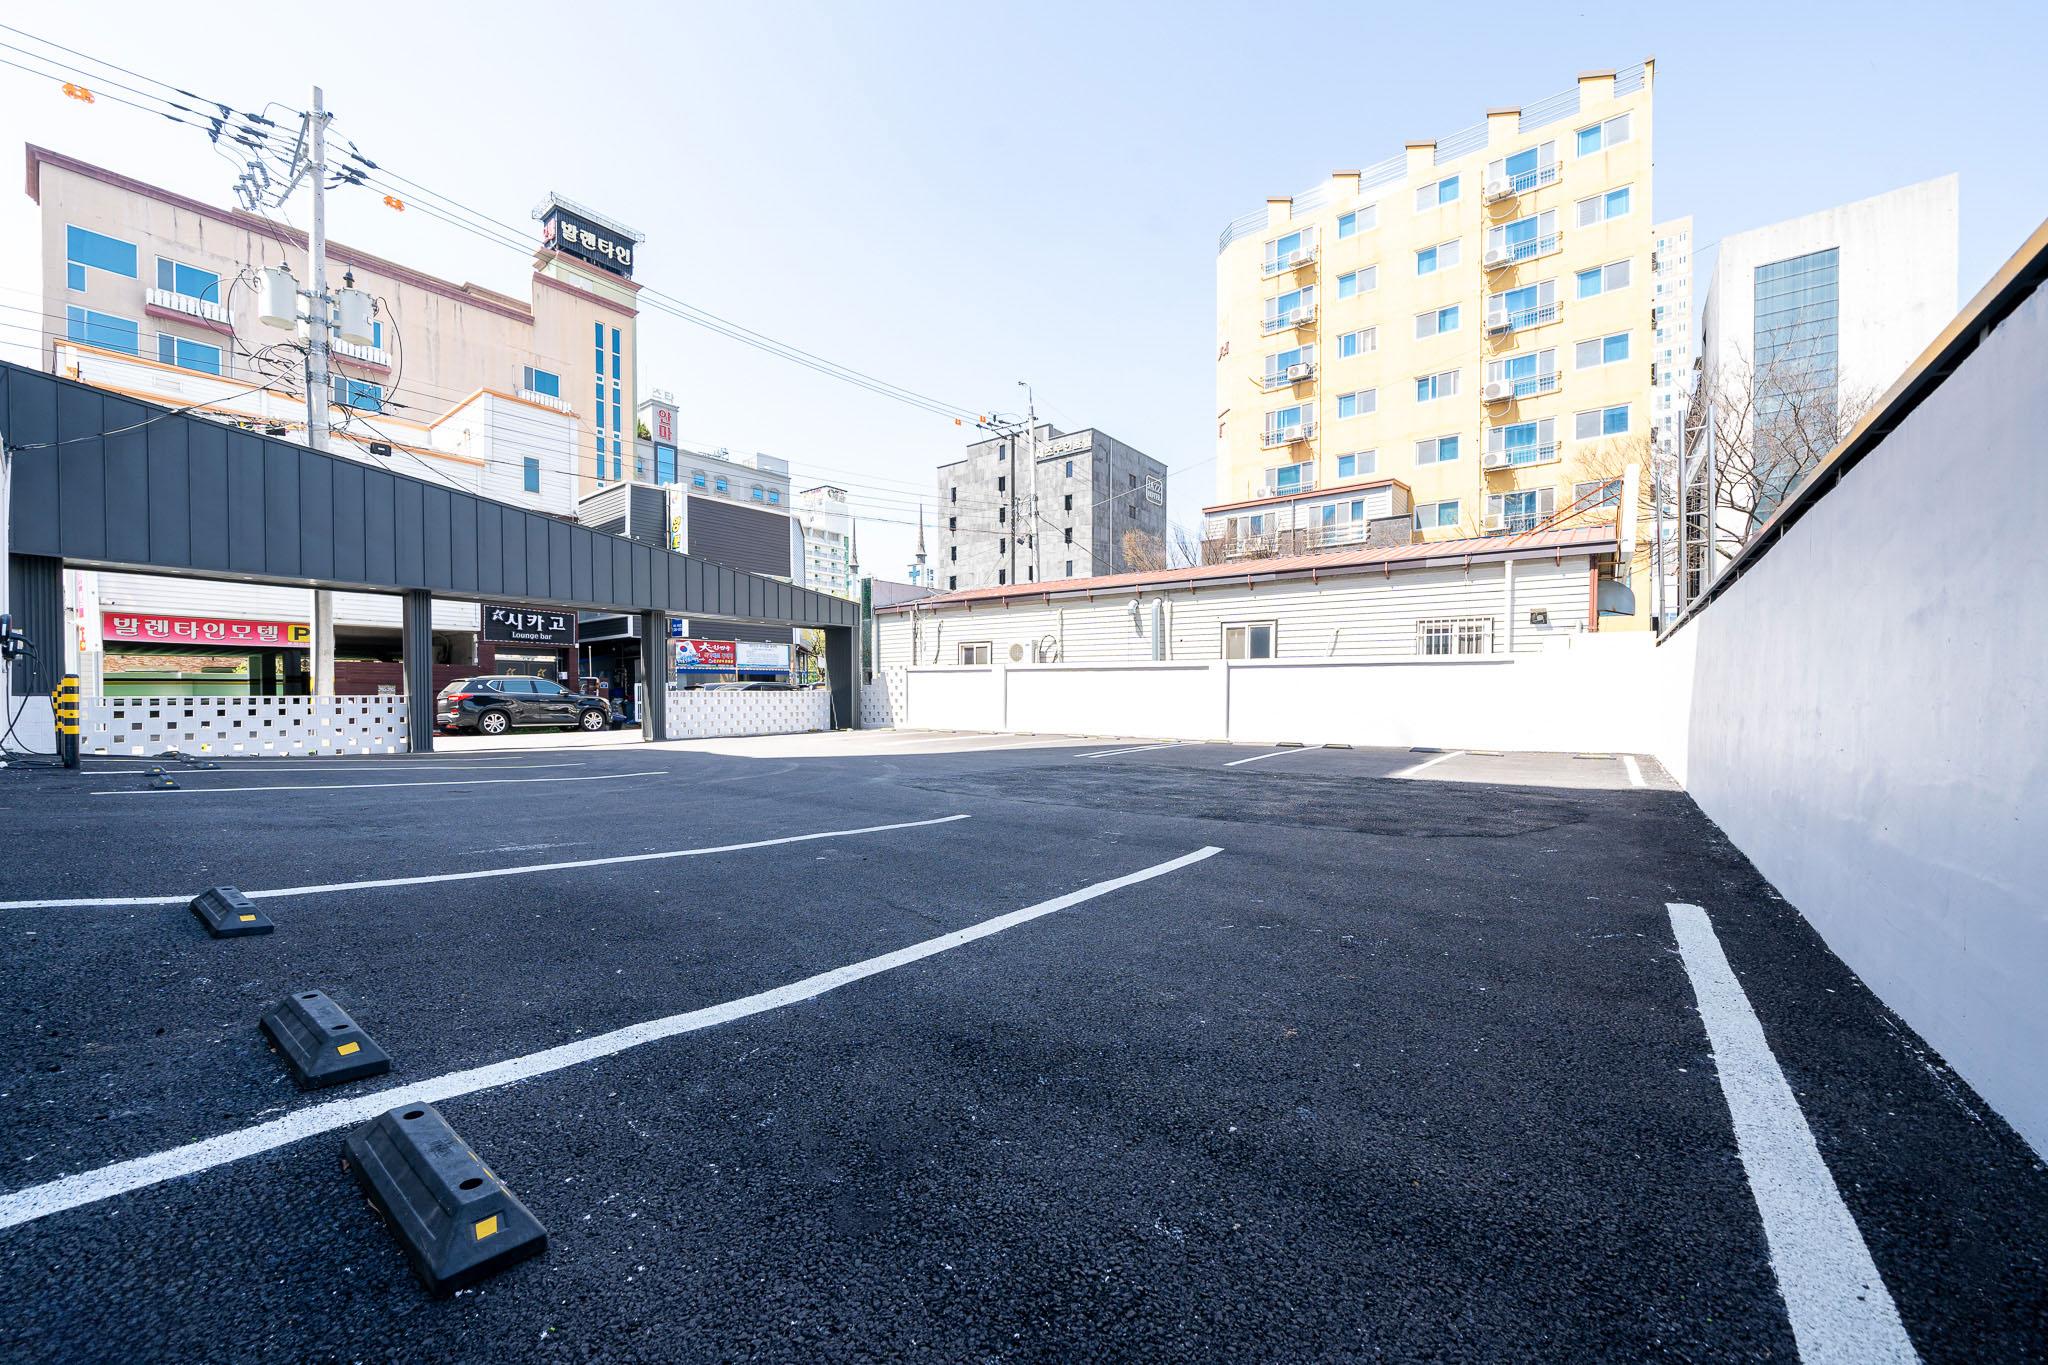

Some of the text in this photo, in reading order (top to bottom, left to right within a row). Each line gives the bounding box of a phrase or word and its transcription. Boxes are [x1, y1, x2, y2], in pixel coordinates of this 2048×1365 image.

[657, 409, 672, 442] 안마
[504, 612, 566, 632] 시카고
[294, 627, 311, 640] P
[512, 631, 539, 640] Lounge
